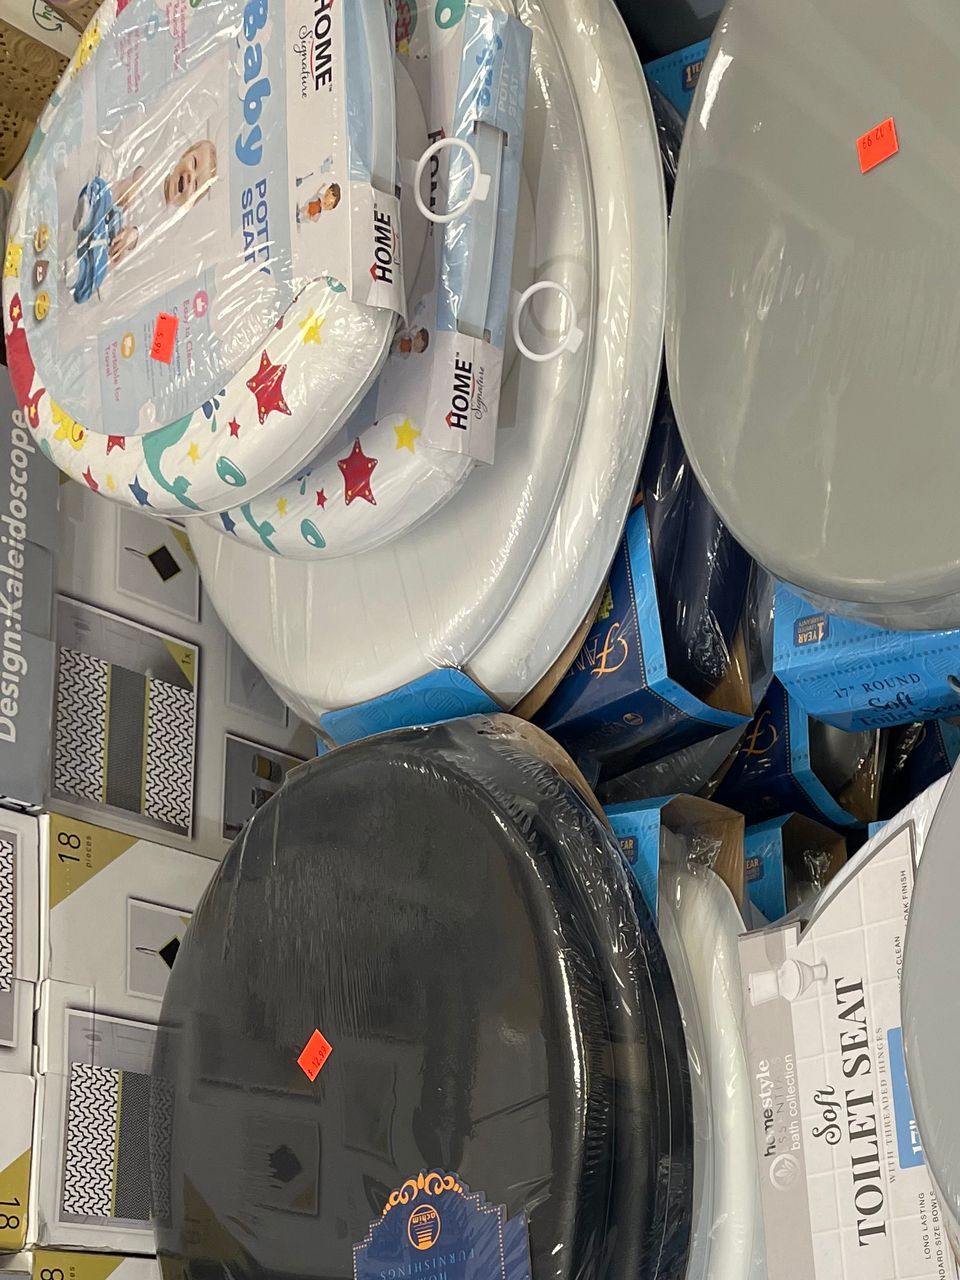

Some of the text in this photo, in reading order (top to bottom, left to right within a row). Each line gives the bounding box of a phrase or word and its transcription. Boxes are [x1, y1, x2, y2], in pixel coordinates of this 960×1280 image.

[234, 0, 271, 166] Baby
[293, 25, 307, 99] Signature
[241, 187, 257, 263] SEAT
[255, 178, 271, 275] POTTY
[862, 673, 921, 693] ROUND
[868, 692, 918, 712] Soft
[57, 832, 81, 864] 18
[784, 1054, 800, 1150] bath collection
[812, 1084, 842, 1146] Soft
[835, 976, 887, 1248] TOILET SEAT
[875, 1027, 896, 1184] WITH THREADED HINGES
[919, 1192, 932, 1260] LONG LASTING
